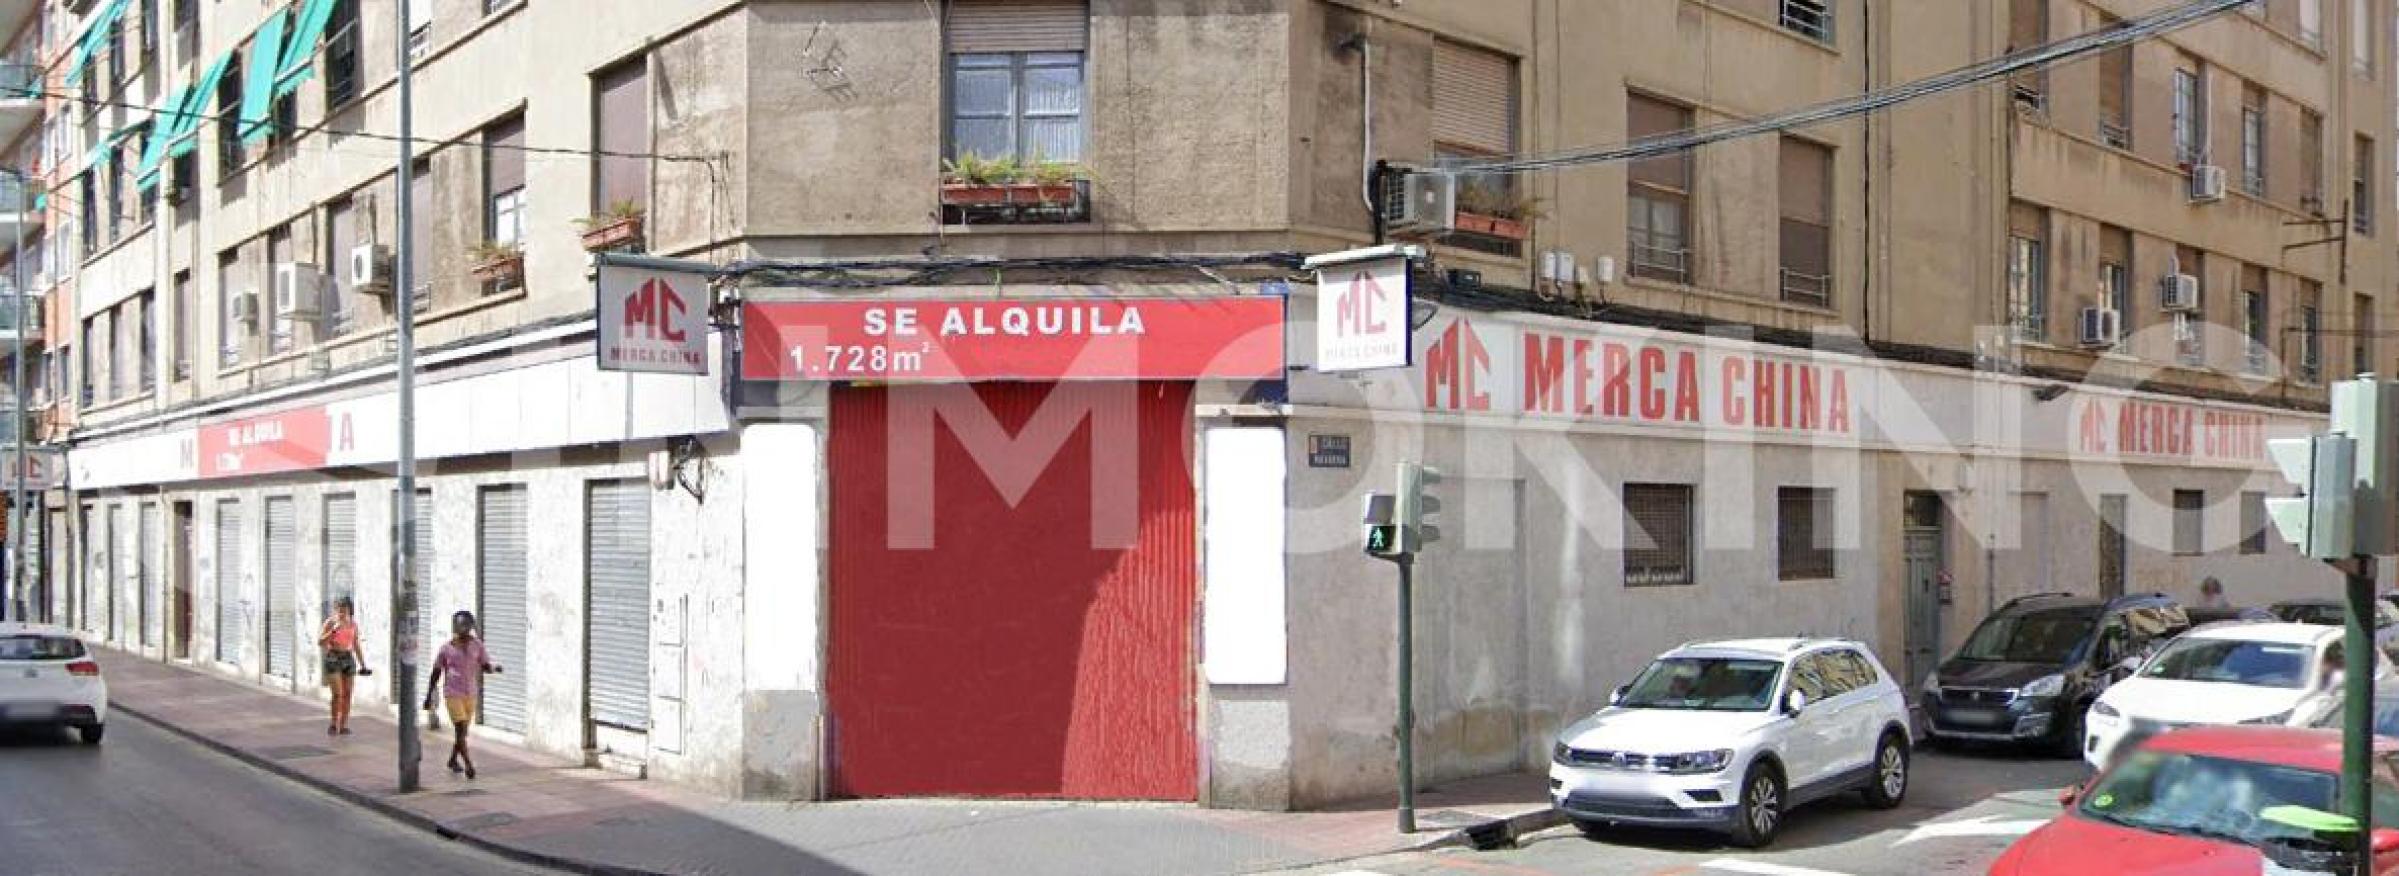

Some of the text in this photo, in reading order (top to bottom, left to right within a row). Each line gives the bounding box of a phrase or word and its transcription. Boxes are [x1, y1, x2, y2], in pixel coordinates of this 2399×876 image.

[625, 277, 686, 342] MC
[863, 306, 1146, 336] SE ALQUILA
[1337, 270, 1386, 338] MC
[610, 346, 700, 364] MERCA CHINA
[1425, 316, 1850, 433] MC MERCA CHINA
[2119, 401, 2194, 455] MERCA
[2204, 410, 2266, 458] CHINA
